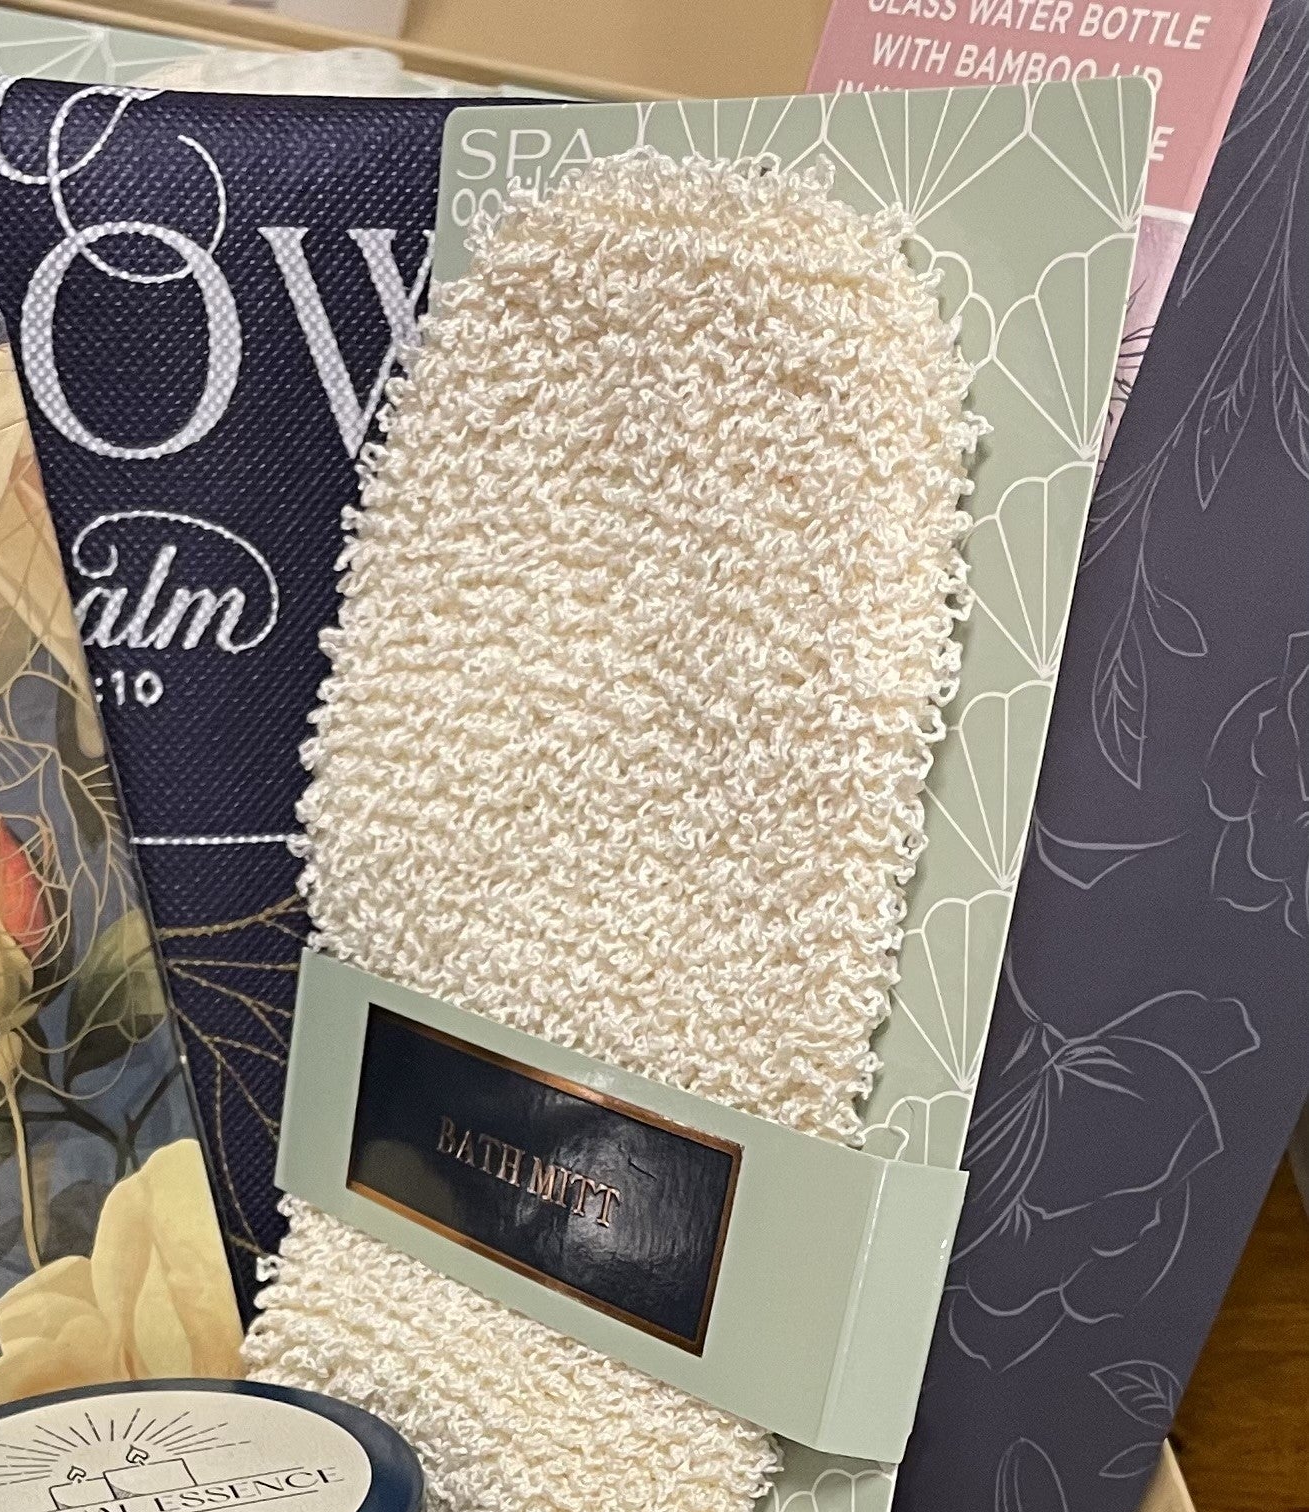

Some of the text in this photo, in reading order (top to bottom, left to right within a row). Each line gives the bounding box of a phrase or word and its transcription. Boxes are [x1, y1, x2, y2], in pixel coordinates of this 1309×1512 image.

[969, 0, 1074, 34] WATER
[1078, 4, 1211, 50] BOTTLE
[872, 32, 952, 74] WITH
[954, 44, 1097, 84] BAMBOO
[456, 128, 595, 180] SPA
[72, 509, 279, 654] alm
[94, 669, 164, 708] :10
[437, 1116, 621, 1229] BATH MITT
[154, 1467, 345, 1512] ESSENCE
